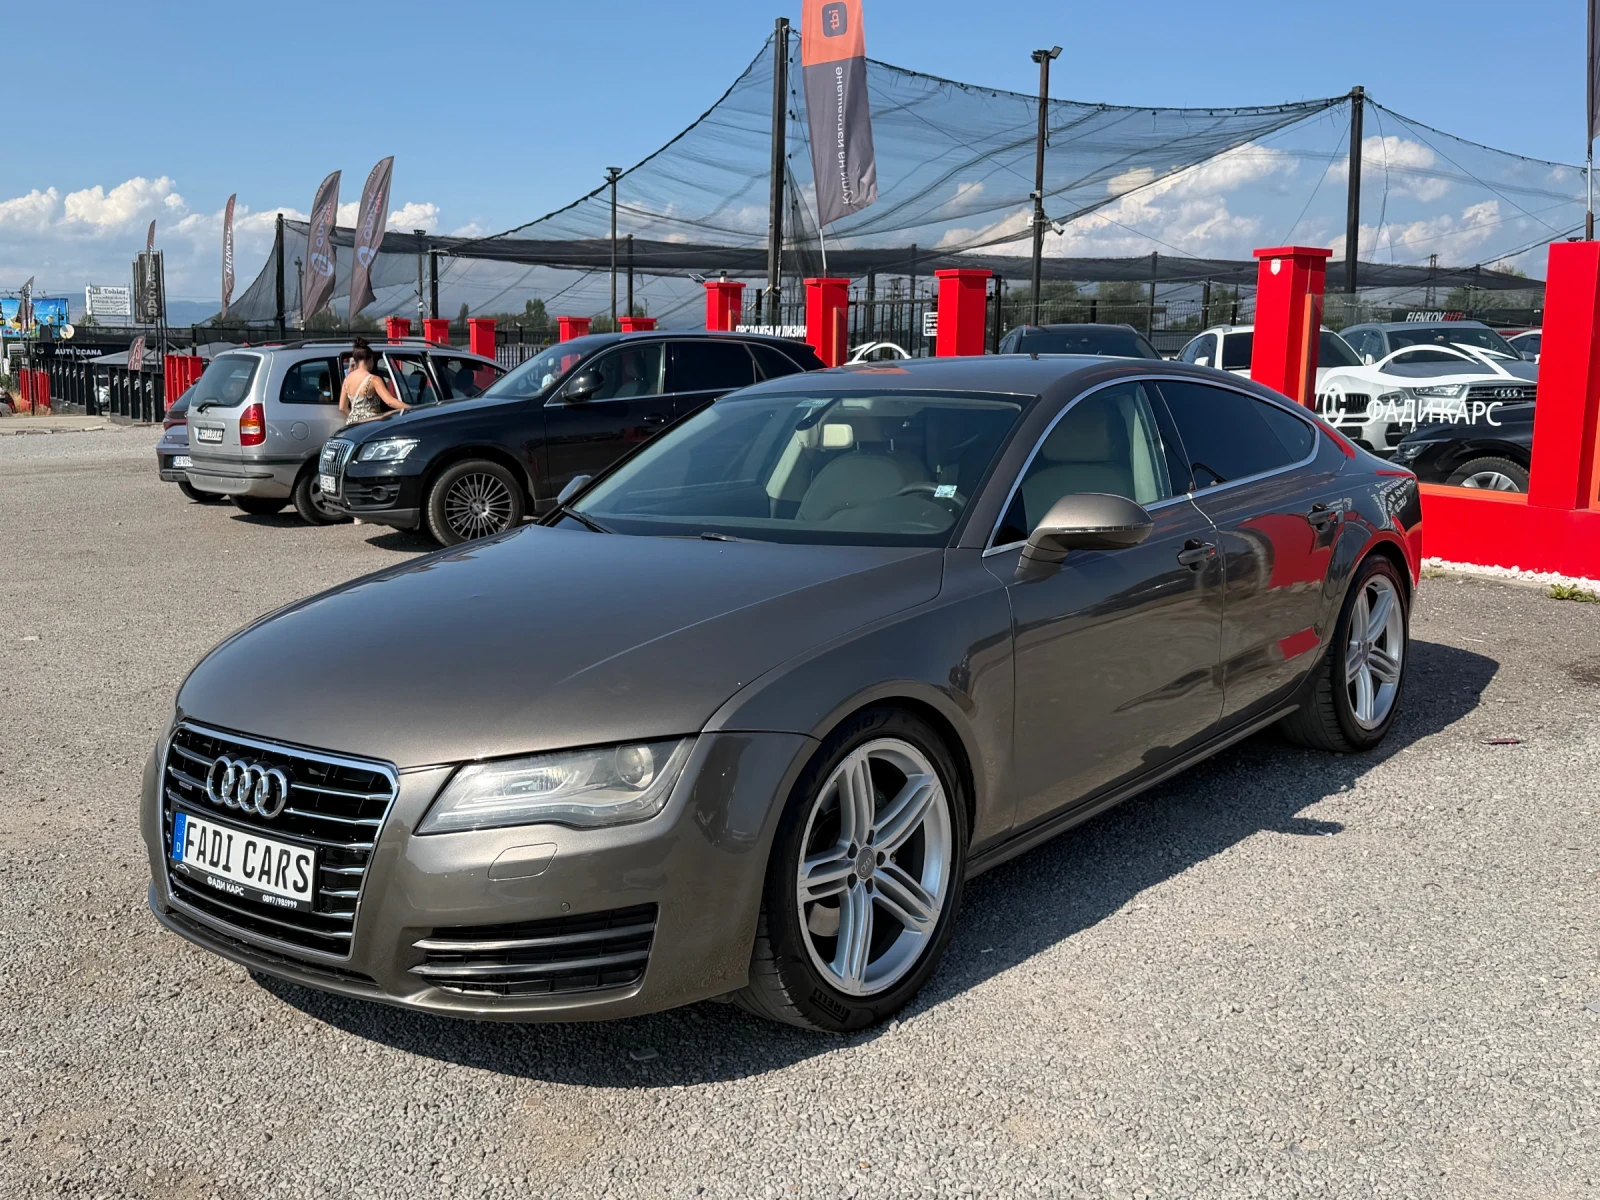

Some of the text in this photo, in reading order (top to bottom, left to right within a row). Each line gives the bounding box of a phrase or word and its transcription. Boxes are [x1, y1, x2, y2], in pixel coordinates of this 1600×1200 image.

[828, 9, 840, 30] tbi
[835, 66, 853, 204] Купи на изплащане
[1366, 398, 1503, 427] ФАДИ КАРС
[185, 821, 311, 893] FADI CARS
[206, 876, 245, 897] ФАДИ КАРС
